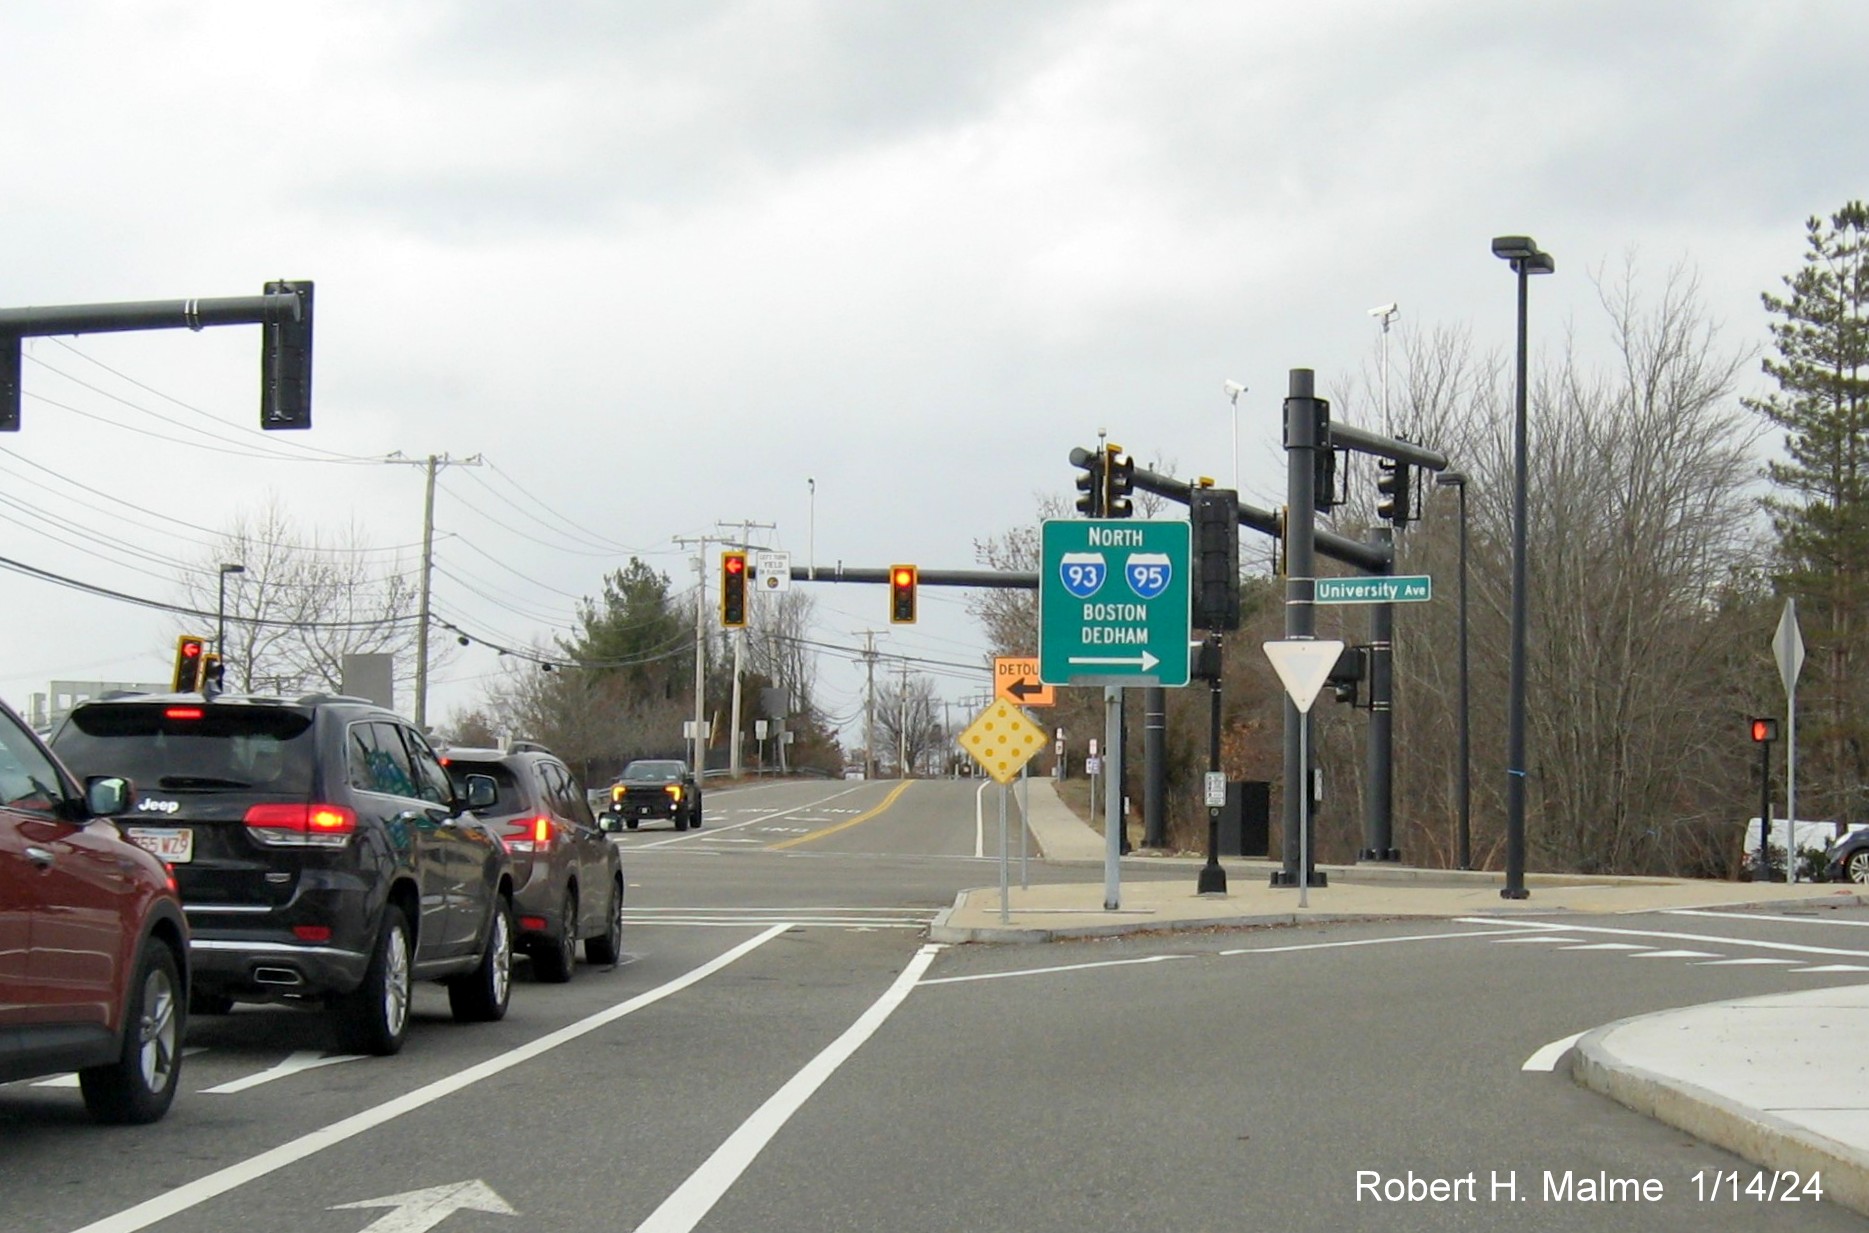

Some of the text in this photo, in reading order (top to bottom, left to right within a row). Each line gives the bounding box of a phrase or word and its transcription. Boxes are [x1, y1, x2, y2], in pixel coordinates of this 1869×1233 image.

[1089, 527, 1143, 546] NORTH
[1068, 566, 1163, 588] 93 95
[1320, 582, 1426, 600] University Ave
[1083, 604, 1146, 621] BOSTON
[1082, 627, 1149, 644] DEDHAM
[999, 664, 1039, 675] DETOU
[138, 798, 179, 814] Jeep
